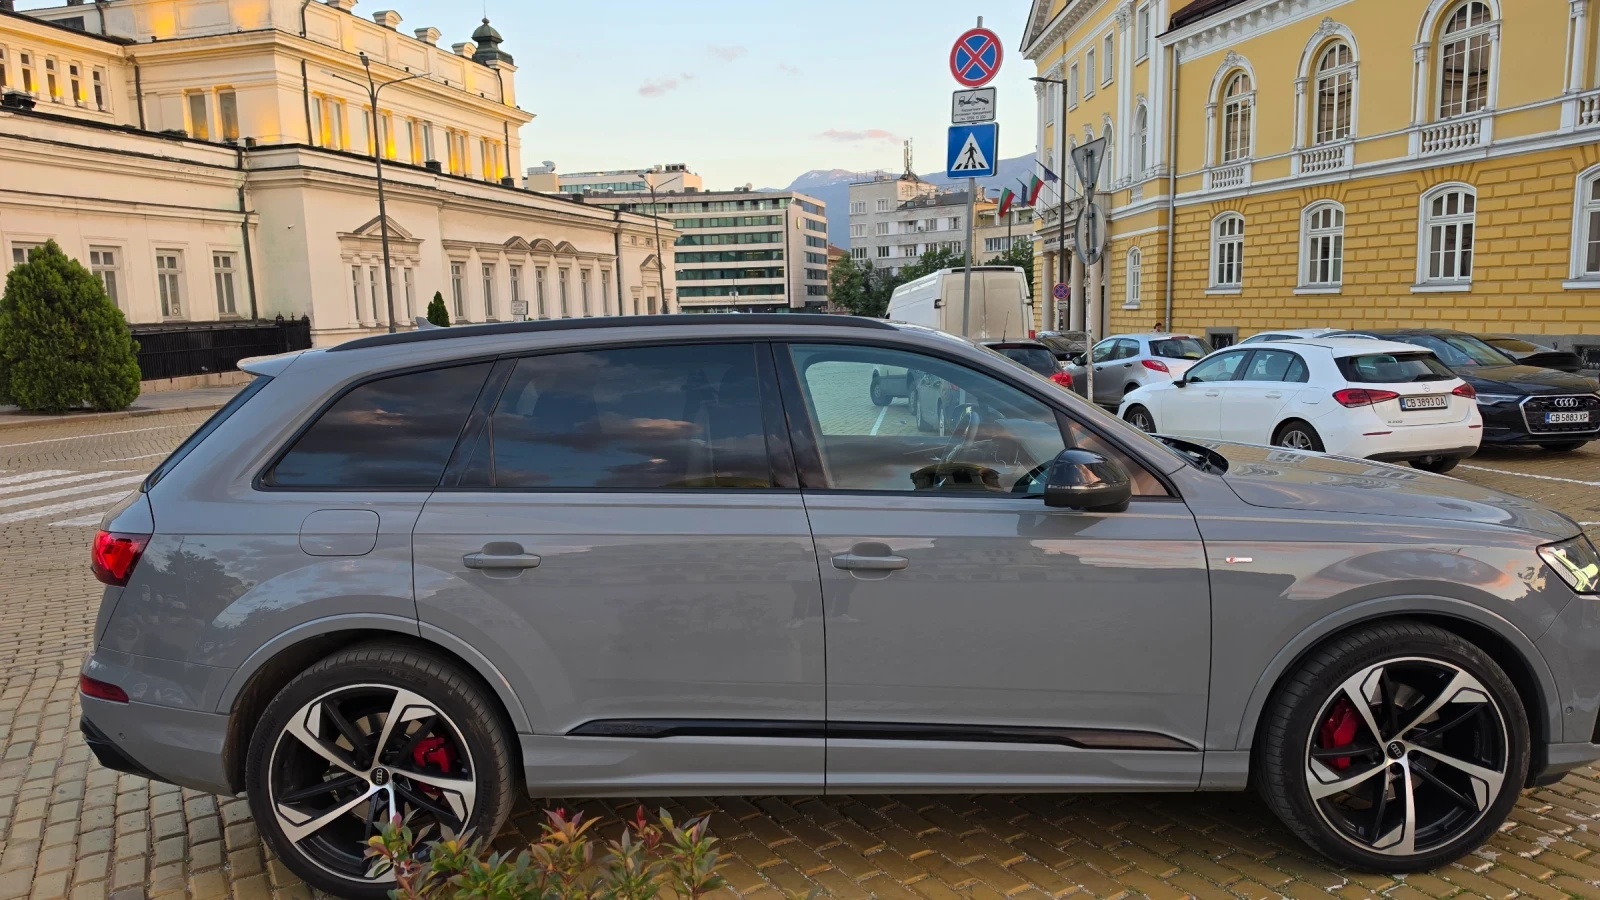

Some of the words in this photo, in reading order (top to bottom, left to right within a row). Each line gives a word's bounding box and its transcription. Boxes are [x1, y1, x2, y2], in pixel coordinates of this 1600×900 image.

[1405, 398, 1416, 407] CB
[1417, 397, 1434, 406] 3893
[1551, 413, 1560, 422] CB
[1561, 413, 1578, 421] 5883
